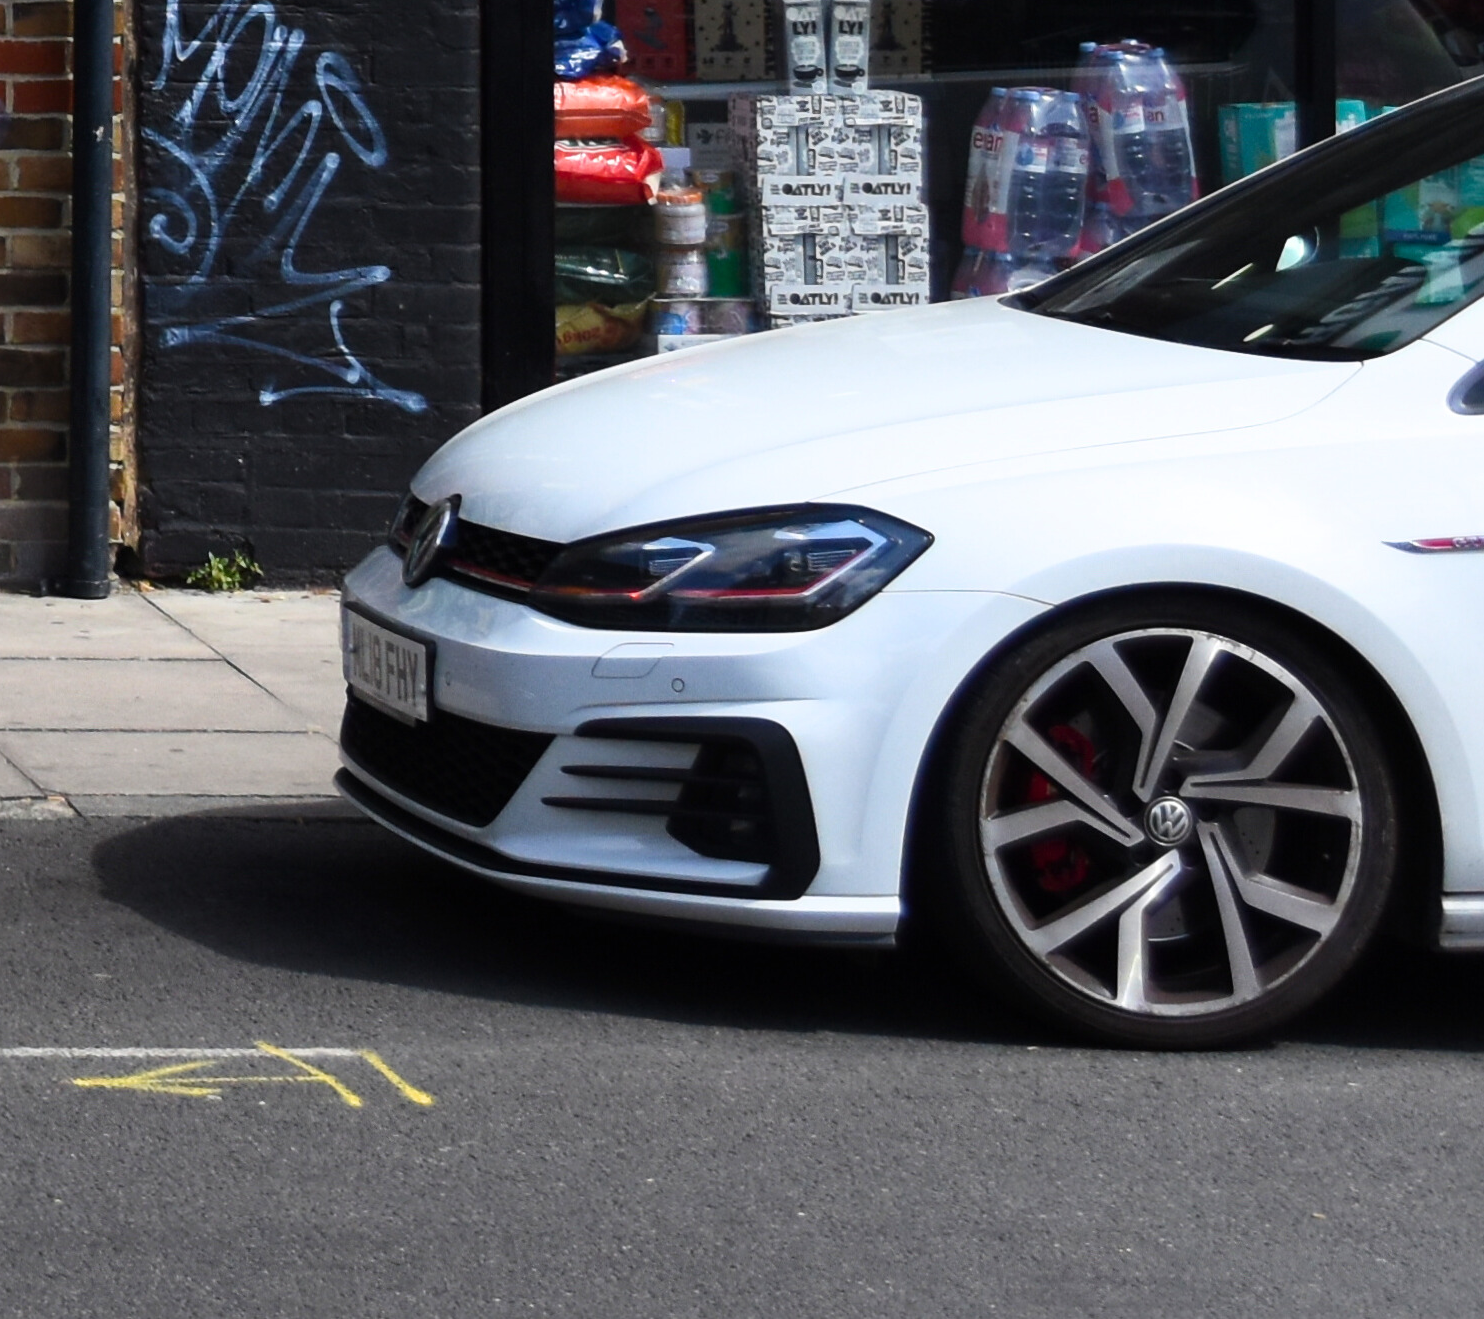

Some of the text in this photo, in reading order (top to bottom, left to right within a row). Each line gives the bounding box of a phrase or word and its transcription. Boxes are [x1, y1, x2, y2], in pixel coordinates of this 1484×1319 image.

[791, 21, 818, 36] LY!
[838, 21, 864, 36] LY!
[781, 183, 832, 197] OATLY!
[861, 181, 912, 196] OATLY!
[789, 291, 840, 306] OATLY!
[870, 290, 921, 305] OATLY!
[385, 640, 418, 707] FHY
